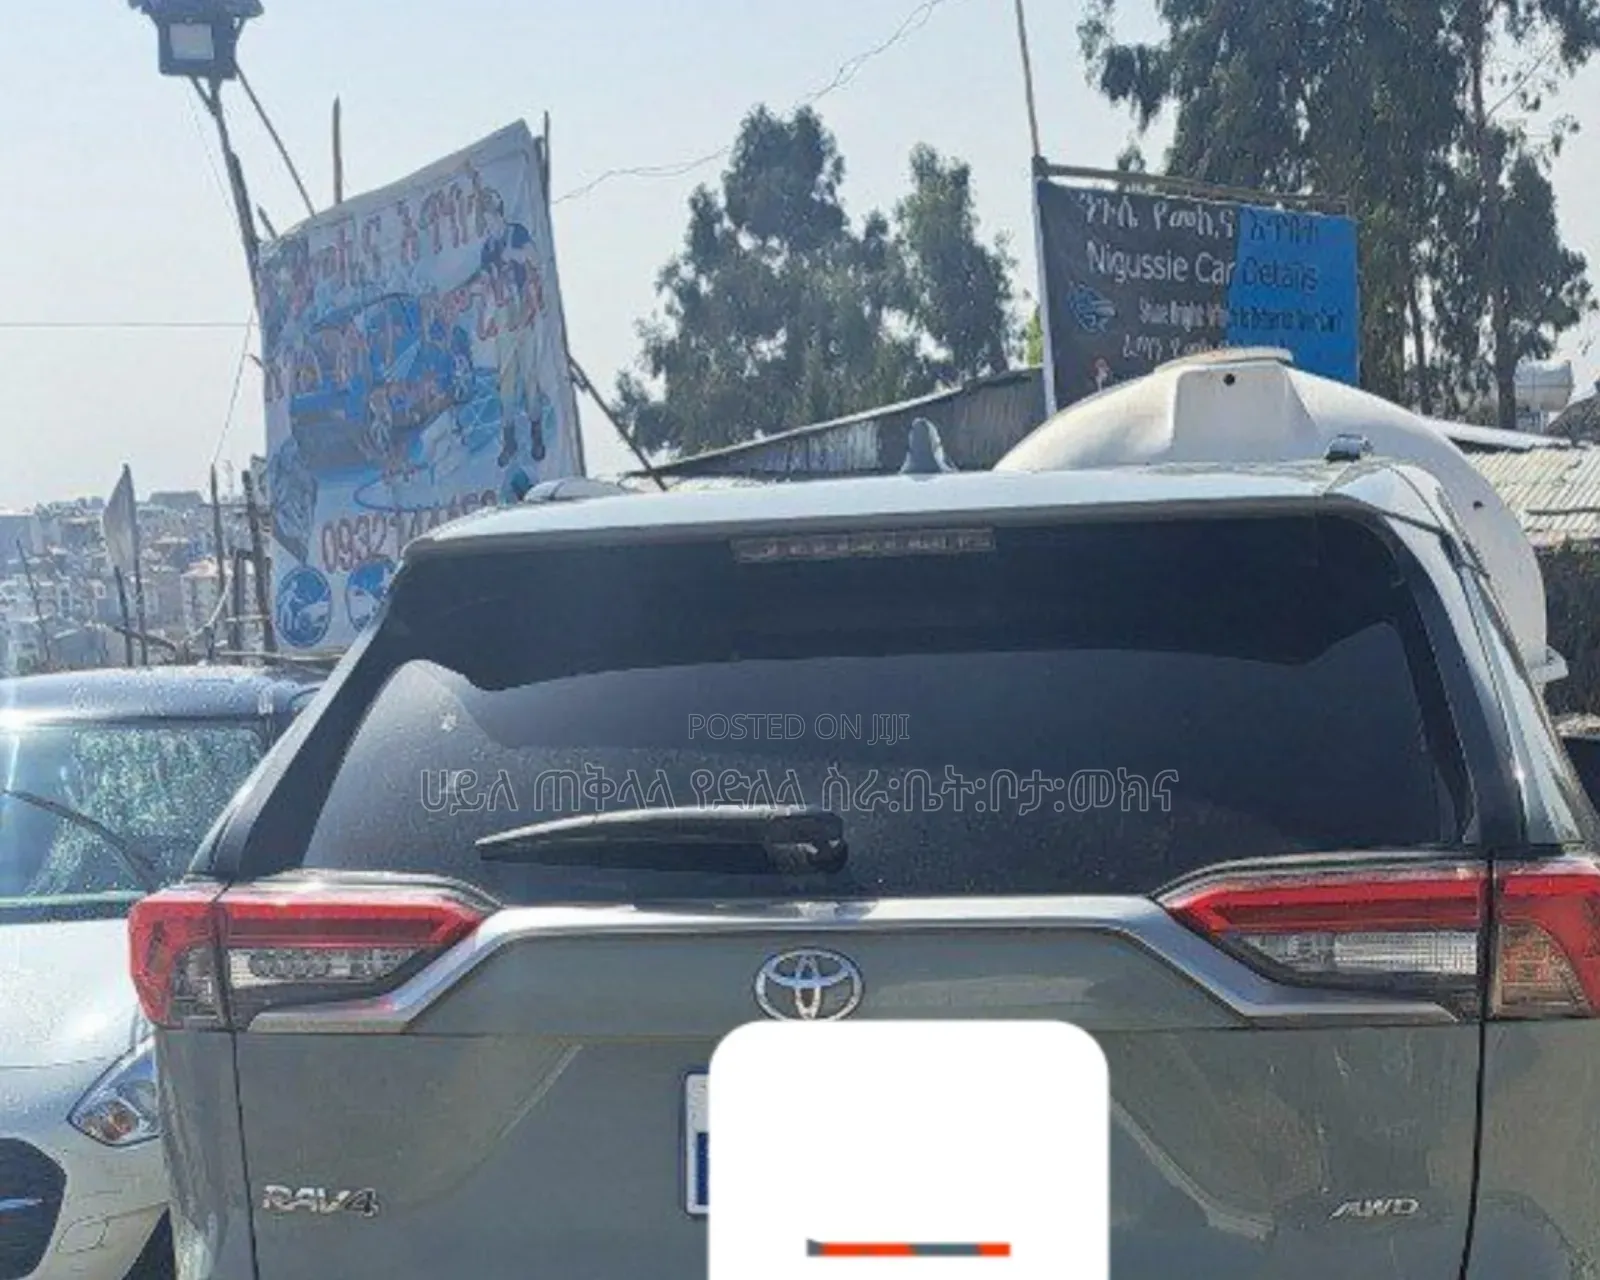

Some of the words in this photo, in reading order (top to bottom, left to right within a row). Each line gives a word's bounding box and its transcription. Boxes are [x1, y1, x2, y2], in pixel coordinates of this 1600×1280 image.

[1086, 240, 1189, 283] Nigussie
[1195, 255, 1236, 285] Car
[263, 1184, 380, 1217] RAV4
[1330, 1198, 1419, 1219] AWD
